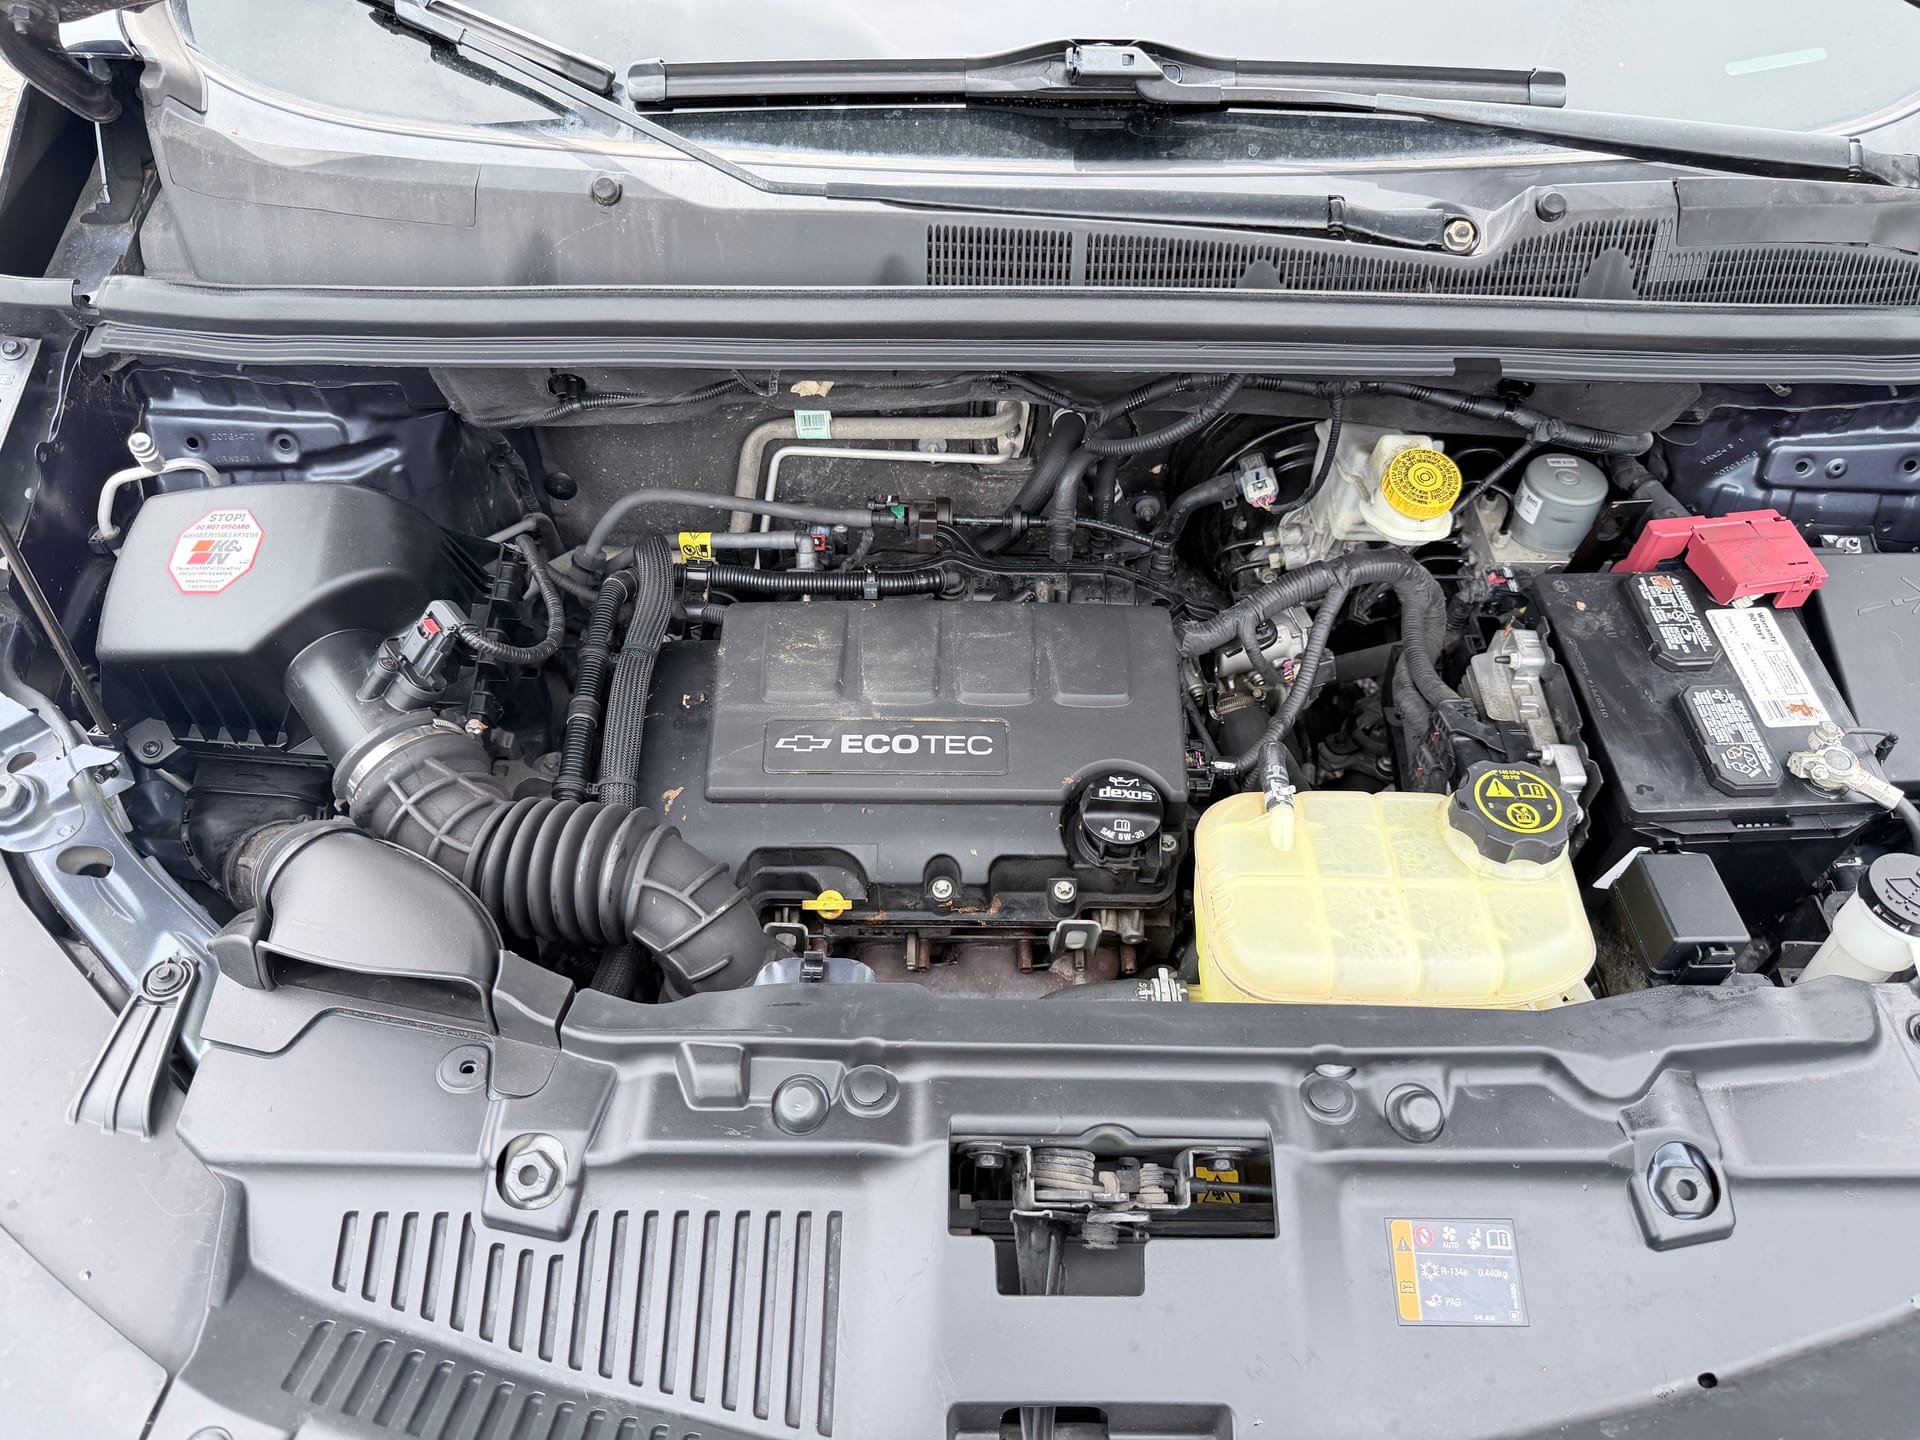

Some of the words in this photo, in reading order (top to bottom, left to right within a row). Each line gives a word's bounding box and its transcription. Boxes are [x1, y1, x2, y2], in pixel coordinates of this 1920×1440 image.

[209, 513, 246, 522] STOP!
[1674, 584, 1696, 614] DANGER
[1692, 619, 1713, 647] POISON
[840, 734, 994, 756] ECOTEC
[1098, 786, 1153, 801] dexos
[1100, 826, 1116, 839] SAE
[1118, 829, 1145, 841] 5W-30
[1441, 1241, 1459, 1249] AUTO
[1440, 1266, 1468, 1277] R-134a
[1478, 1268, 1508, 1280] 0.440kg
[1445, 1297, 1462, 1308] PAG
